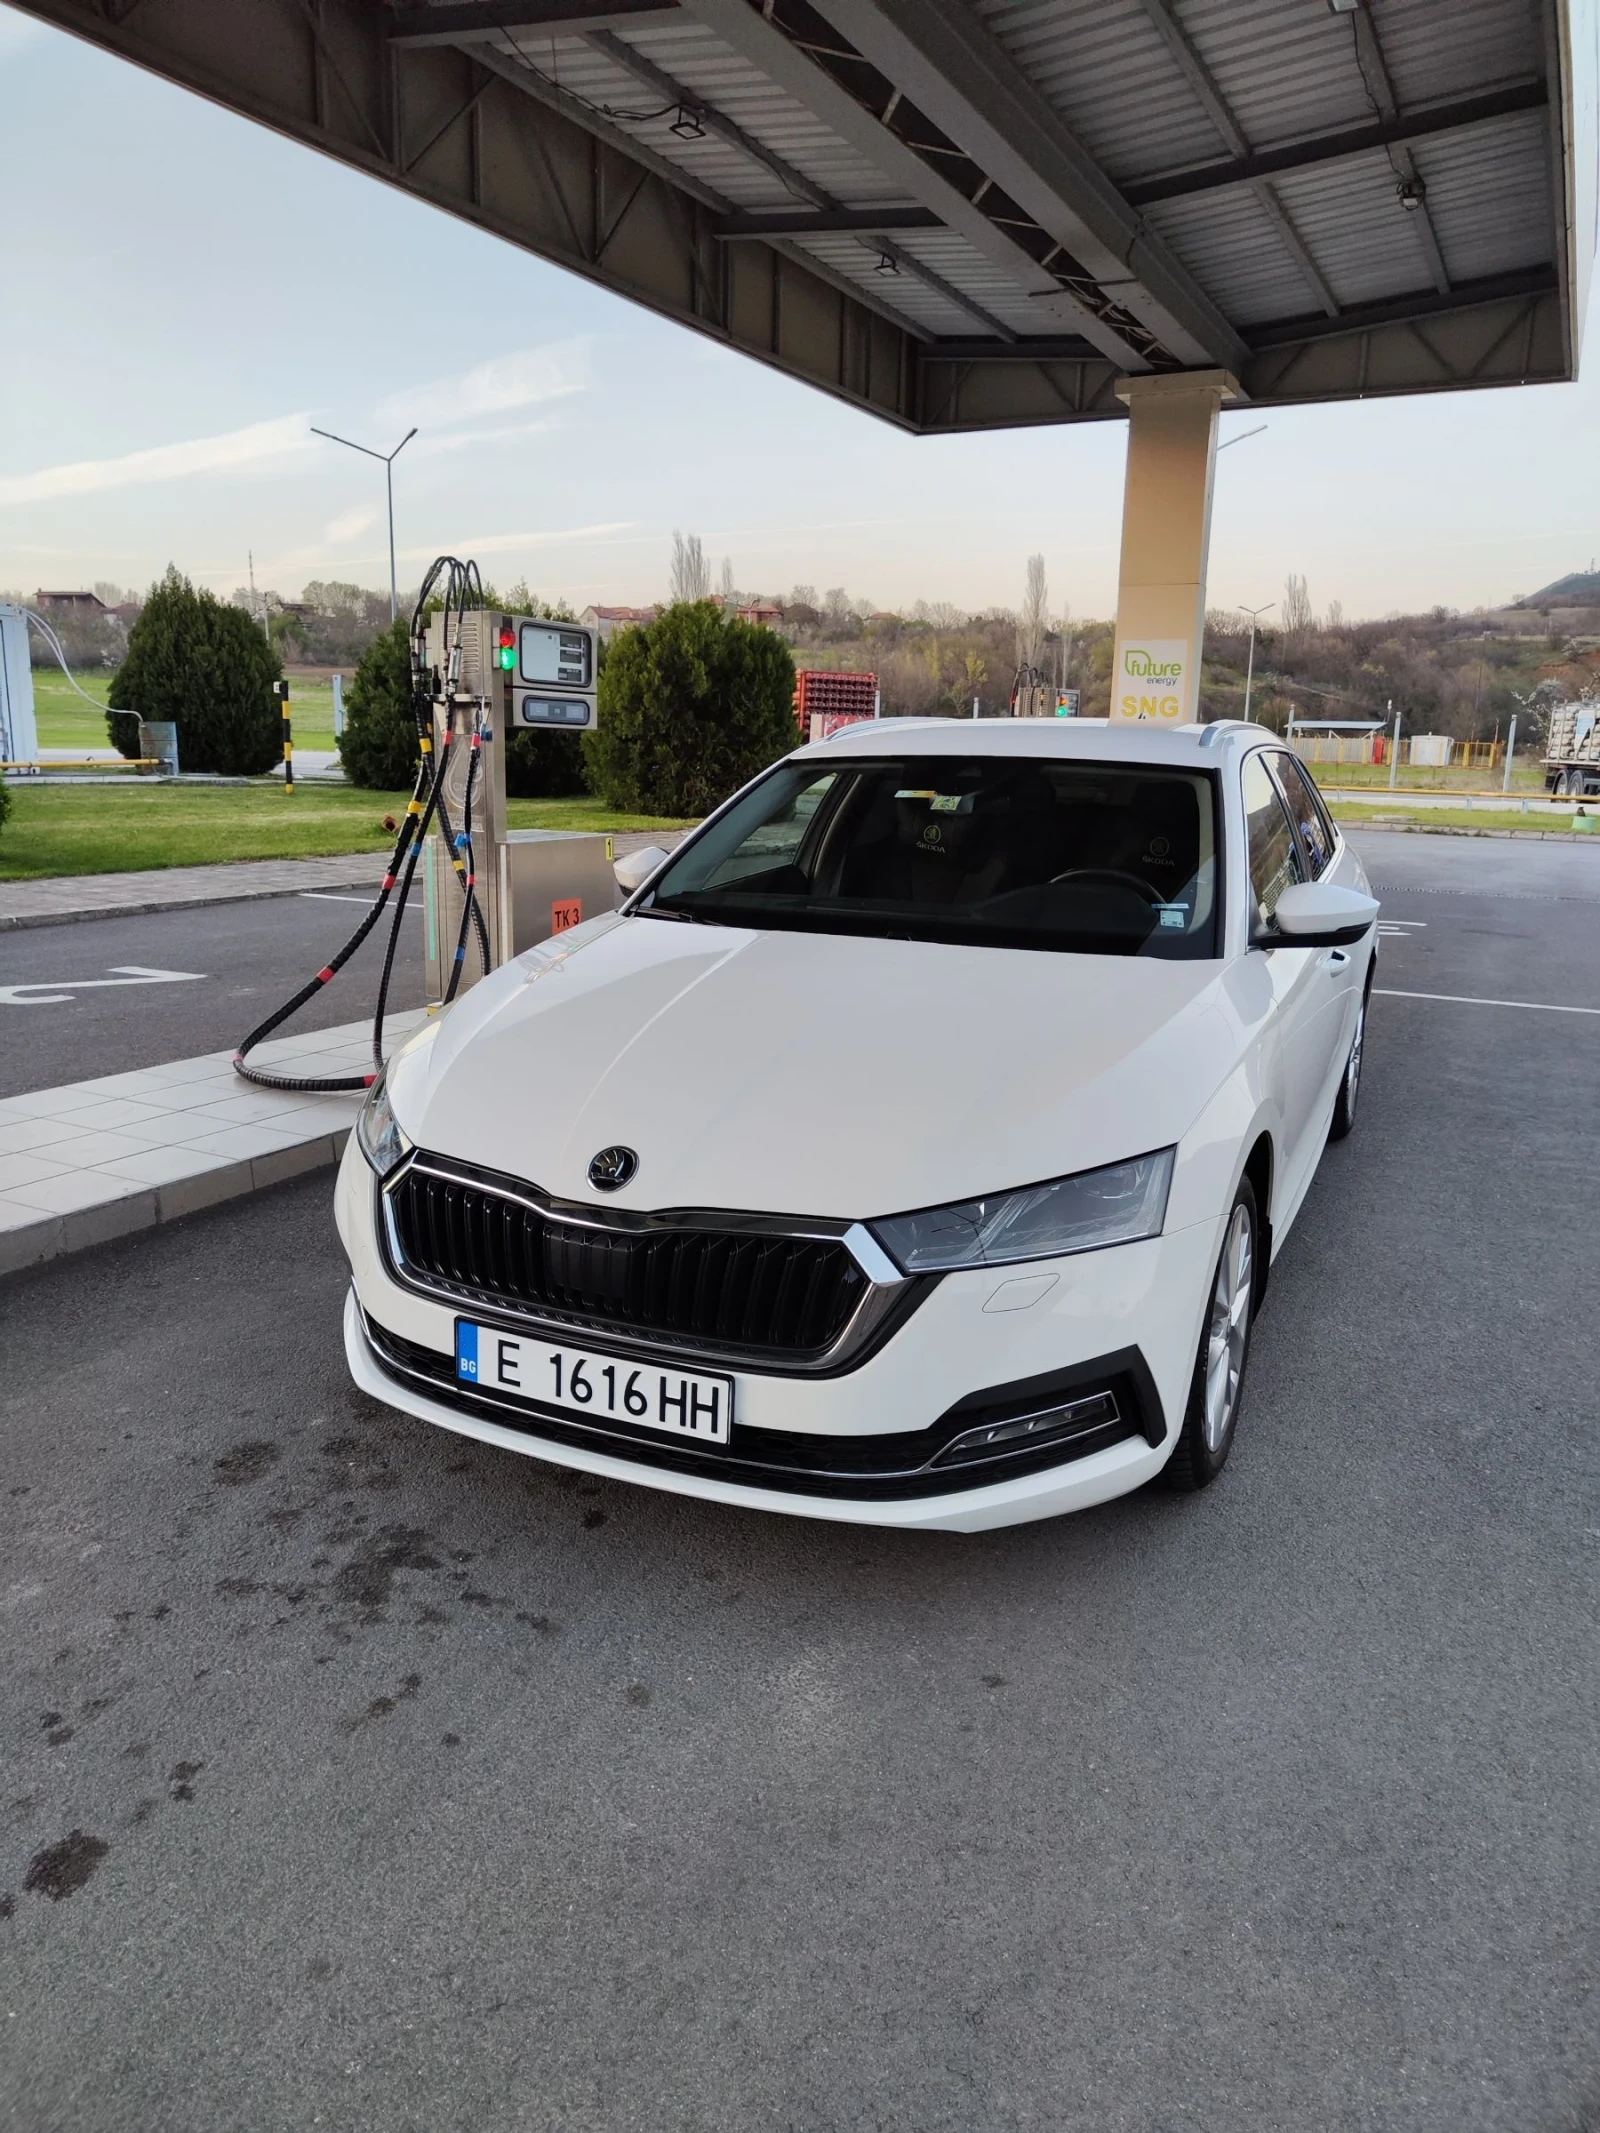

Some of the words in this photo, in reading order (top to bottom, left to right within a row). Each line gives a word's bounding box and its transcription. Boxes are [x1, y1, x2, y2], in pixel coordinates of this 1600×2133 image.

[1129, 660, 1182, 676] future
[1146, 677, 1177, 687] energy
[1121, 696, 1179, 717] SNG
[554, 909, 570, 928] TK
[573, 907, 579, 925] 3
[460, 1357, 476, 1374] BG
[498, 1339, 520, 1387] E
